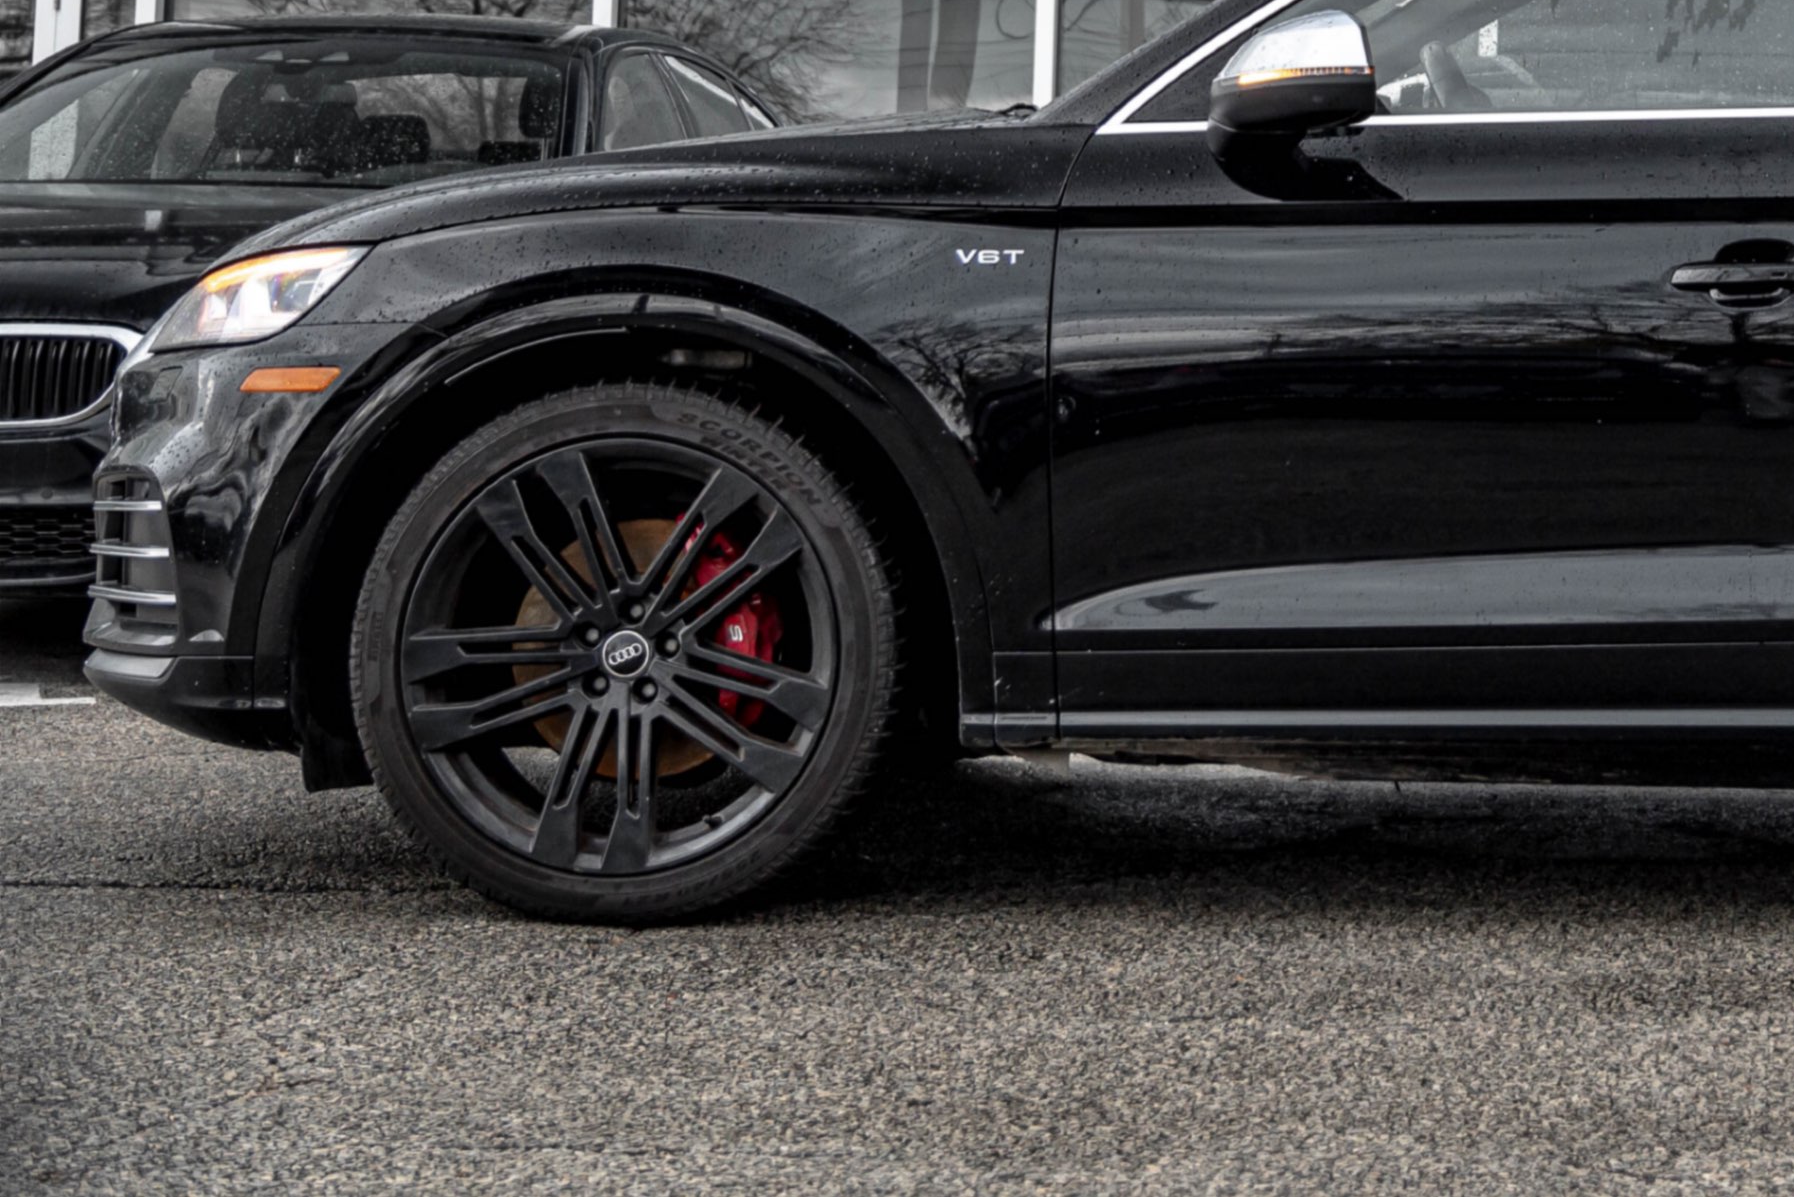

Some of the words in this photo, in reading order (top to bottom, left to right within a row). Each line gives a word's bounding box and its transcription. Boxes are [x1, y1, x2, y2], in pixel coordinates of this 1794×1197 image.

[955, 248, 1025, 265] V6T
[676, 412, 823, 505] SCORPION
[699, 435, 790, 491] WINTER
